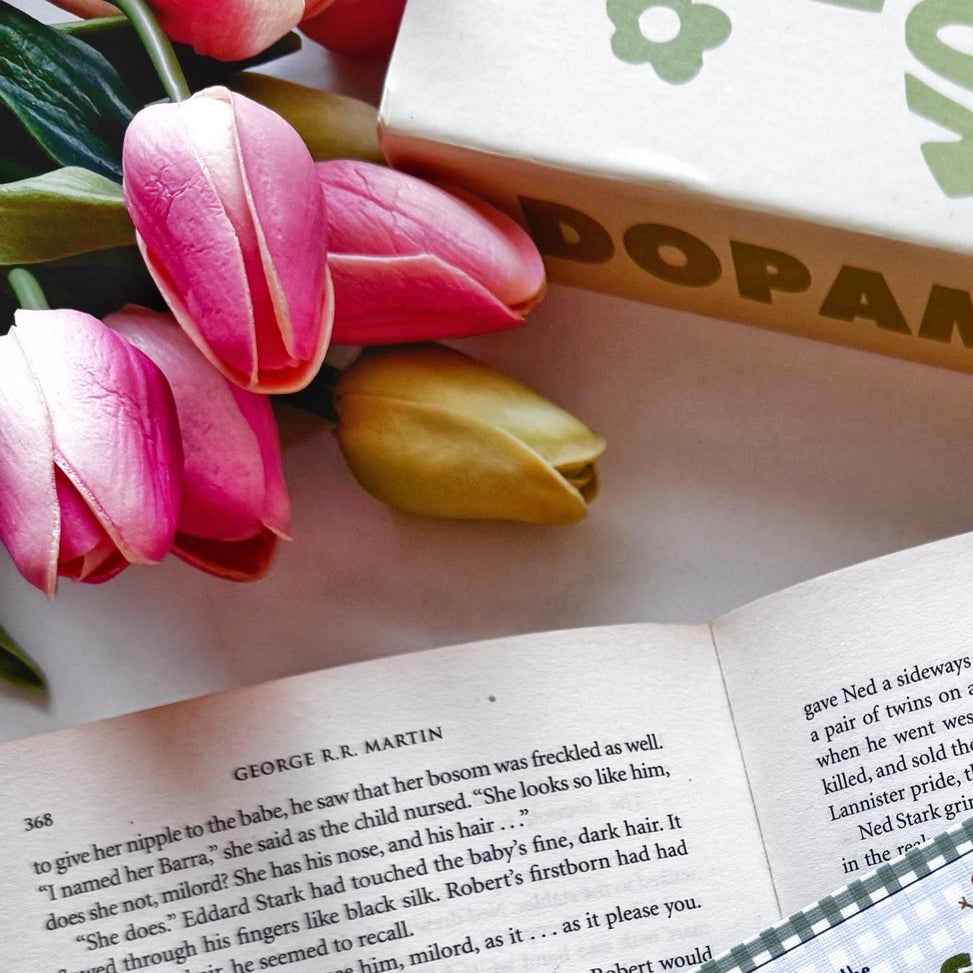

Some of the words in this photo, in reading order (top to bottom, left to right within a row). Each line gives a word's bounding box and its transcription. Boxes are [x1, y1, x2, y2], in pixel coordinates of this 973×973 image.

[803, 694, 839, 721] gave
[840, 676, 879, 704] Ned
[881, 678, 893, 692] a
[896, 655, 972, 687] sideways
[233, 751, 316, 782] GEORGE
[320, 744, 358, 763] R.R.
[364, 725, 443, 754] MARTIN
[23, 812, 54, 832] 368
[181, 895, 252, 928] Eddard
[255, 884, 306, 911] Stark
[307, 874, 347, 900] had
[350, 857, 429, 890] touched
[432, 852, 465, 873] the
[531, 833, 575, 853] fine,
[578, 821, 622, 845] dark
[622, 819, 665, 837] hair.
[666, 813, 683, 830] It
[122, 939, 198, 972] through
[201, 934, 232, 953] his
[236, 919, 301, 945] fingers
[303, 908, 340, 930] like
[343, 894, 398, 921] black
[402, 886, 441, 909] silk.
[528, 856, 612, 883] firstborn
[614, 843, 652, 866] had
[653, 838, 689, 860] had
[658, 945, 713, 971] would
